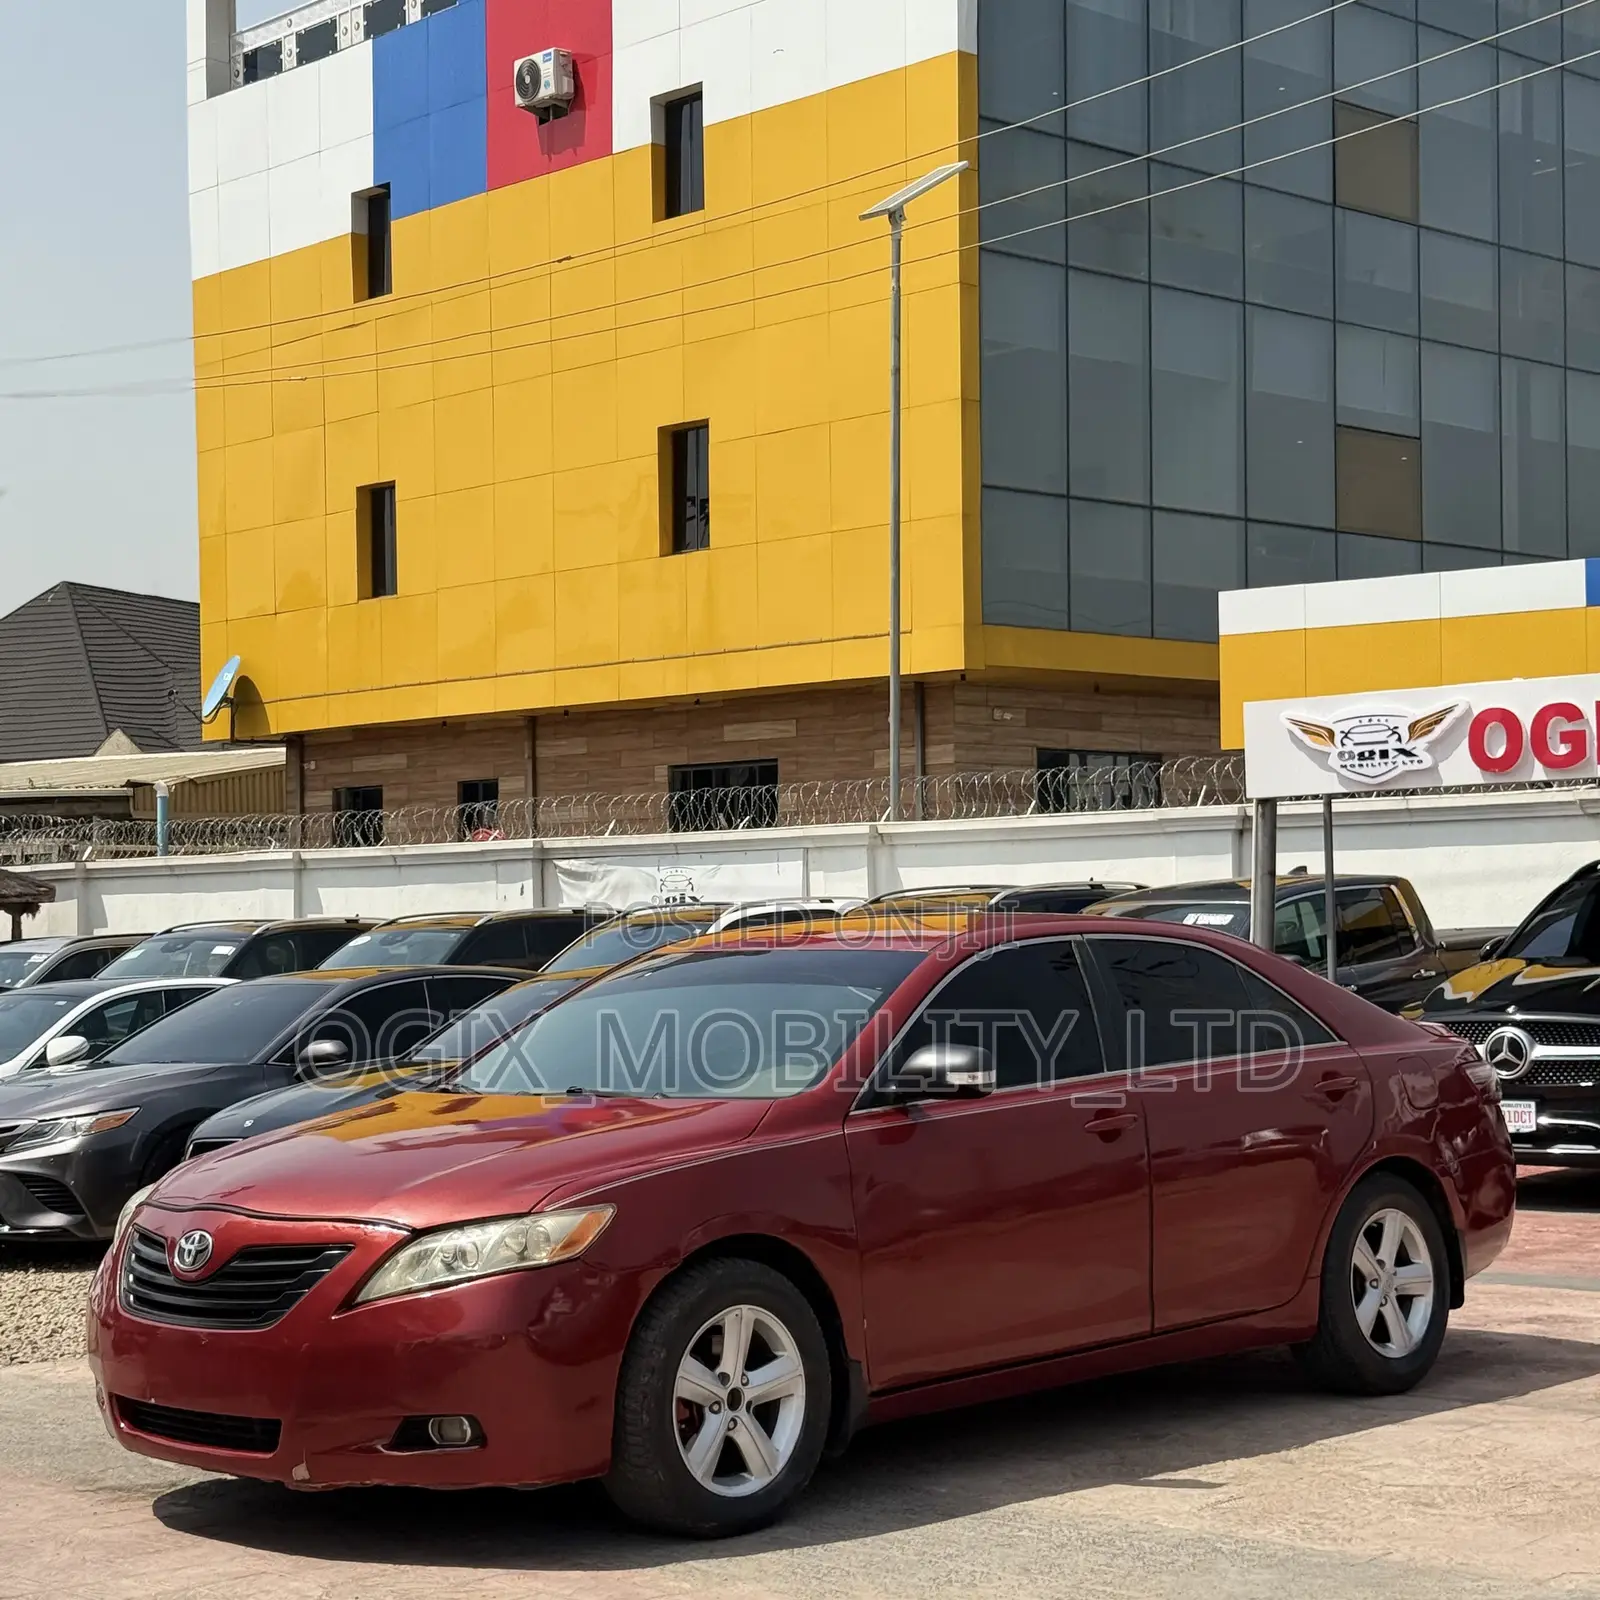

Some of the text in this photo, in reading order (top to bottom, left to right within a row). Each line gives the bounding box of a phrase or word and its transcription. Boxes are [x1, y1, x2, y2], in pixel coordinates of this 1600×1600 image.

[1468, 701, 1600, 773] OG
[1340, 760, 1398, 769] MOBILITY
[1502, 1110, 1532, 1123] 1DCT
